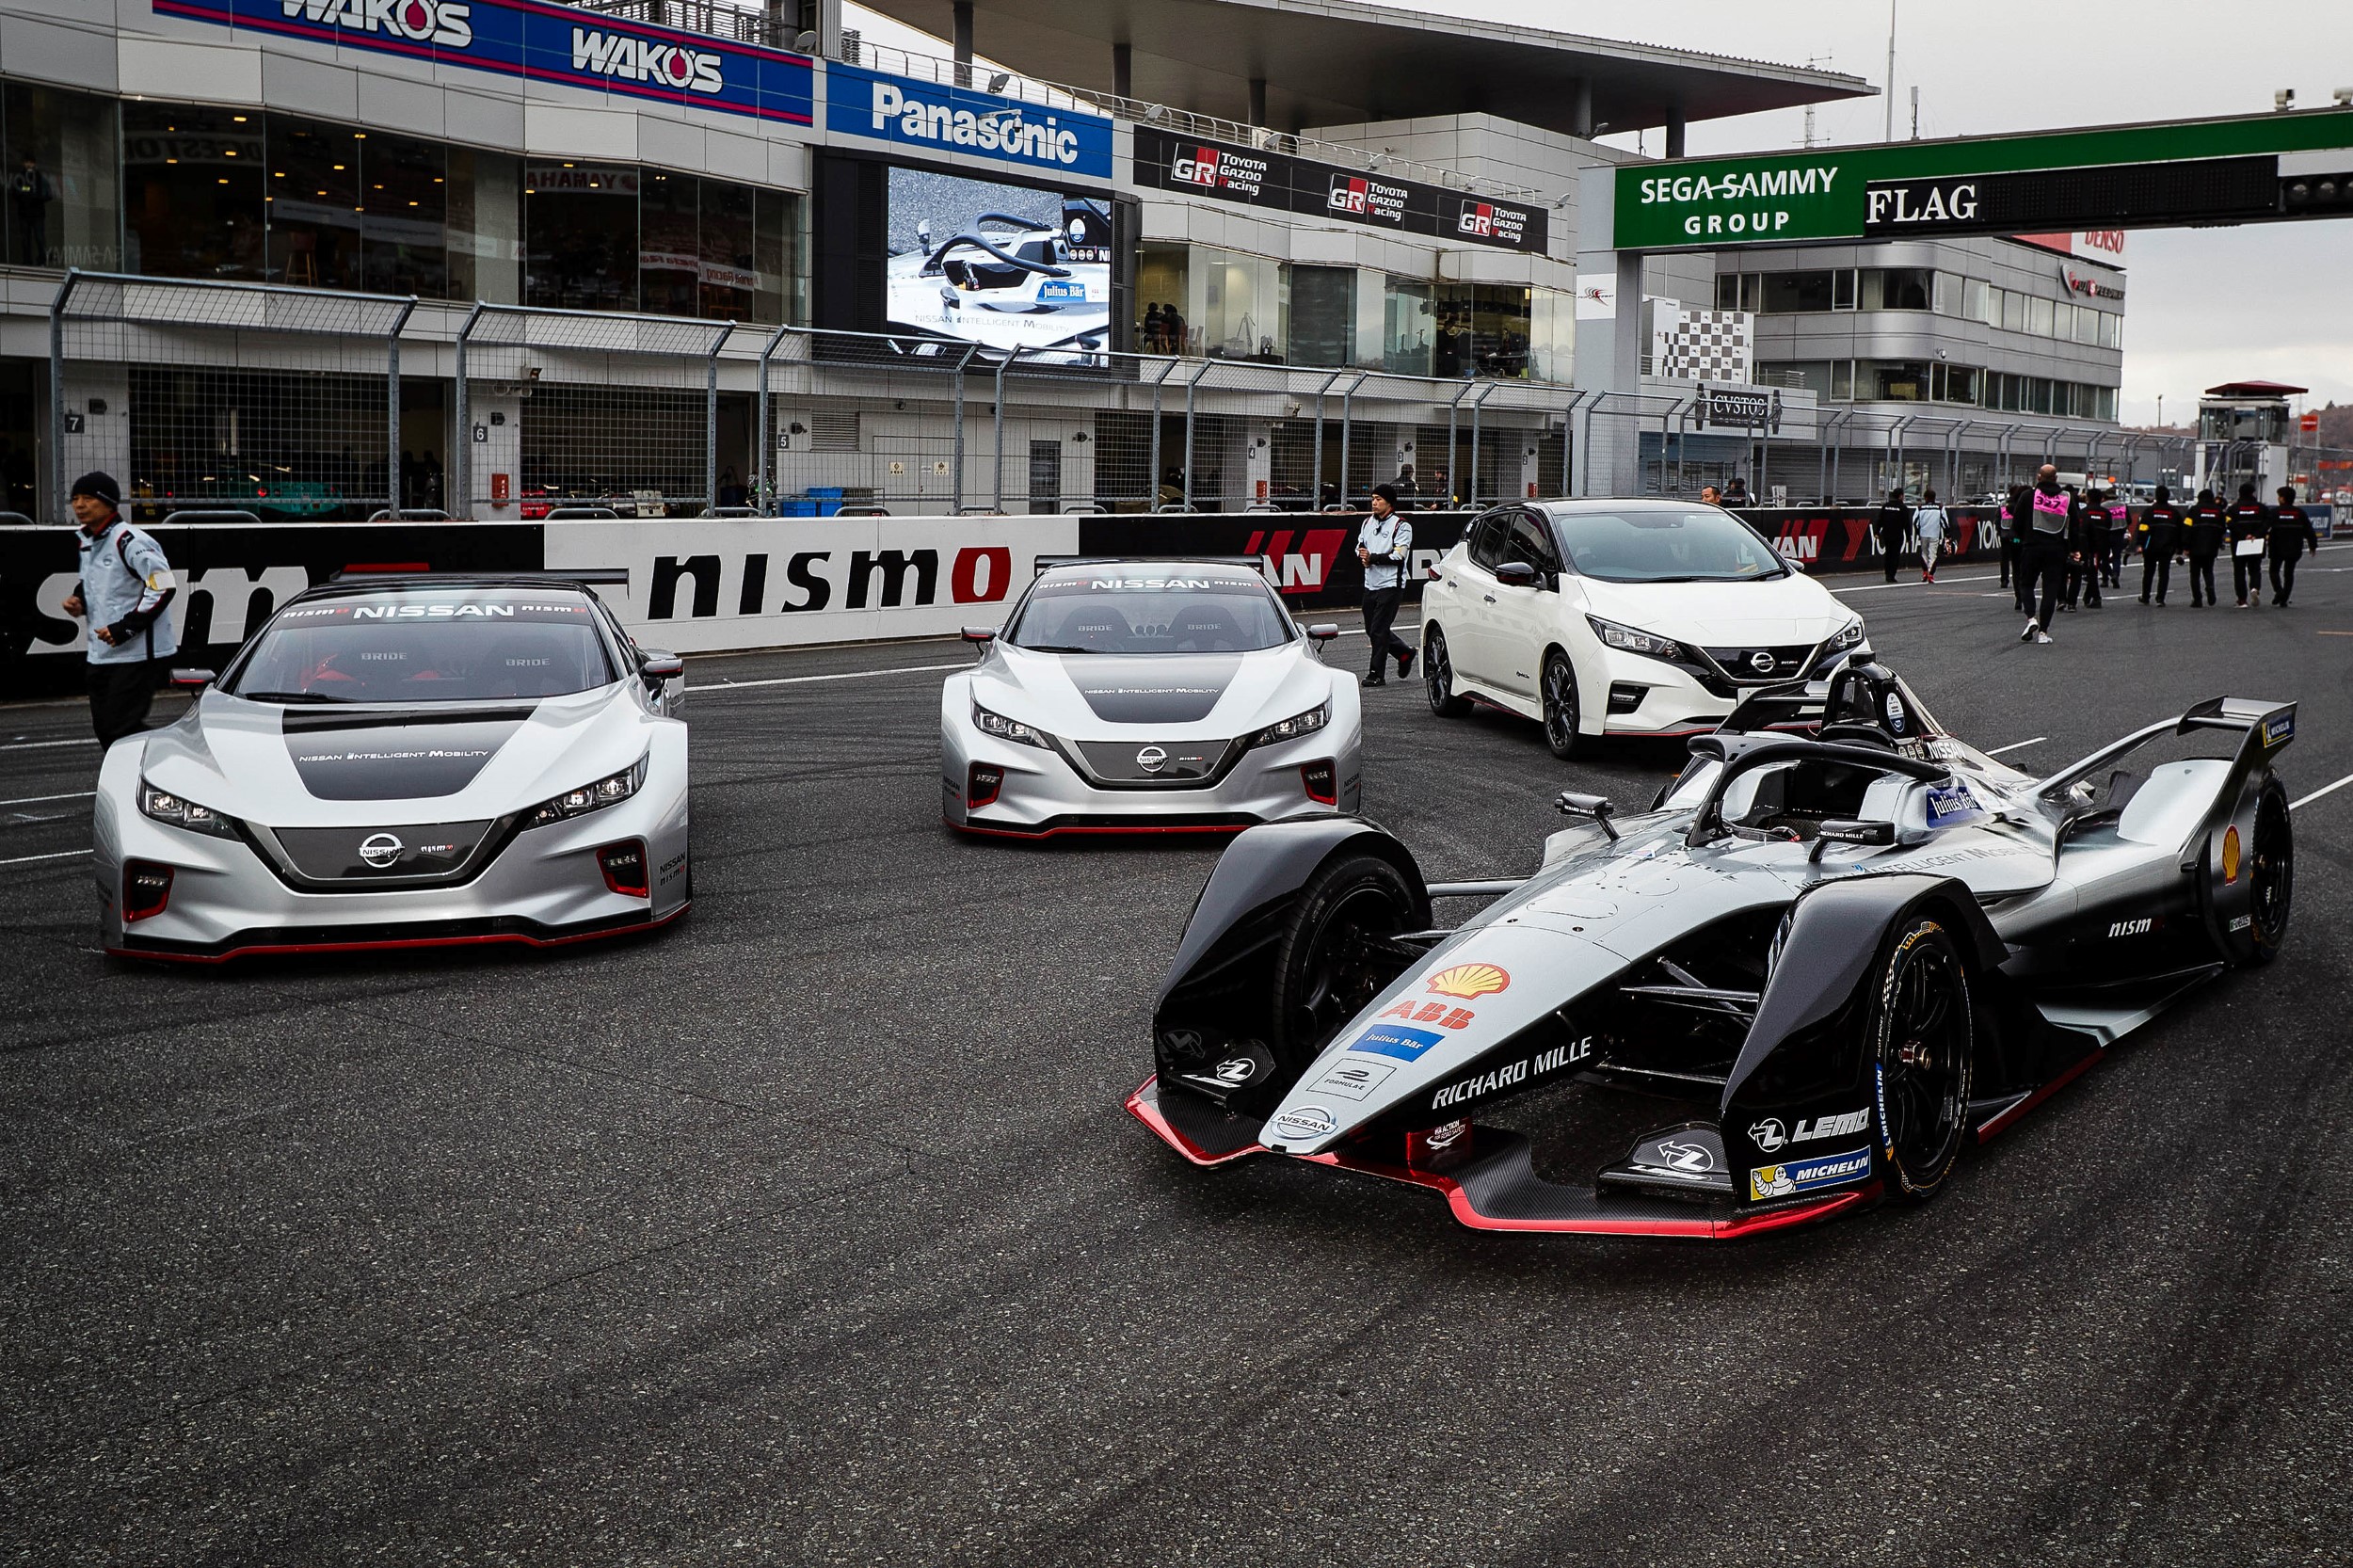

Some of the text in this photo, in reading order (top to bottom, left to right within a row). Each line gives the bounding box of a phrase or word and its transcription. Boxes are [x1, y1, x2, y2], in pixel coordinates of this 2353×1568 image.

[573, 27, 722, 93] WAKO'S
[872, 81, 1078, 164] Panasonic
[1222, 152, 1267, 171] TOYOTA
[1175, 158, 1214, 184] GR
[1220, 165, 1261, 182] GAZOO
[1218, 176, 1259, 196] Racing
[1369, 182, 1408, 199] TOYOTA
[1641, 167, 1838, 204] SEGA SAMMY
[1330, 188, 1364, 211] GR
[1368, 193, 1403, 208] GAZOO
[1866, 184, 1978, 224] FLAG
[1367, 204, 1401, 221] Racing
[1494, 207, 1527, 222] TOYOTA
[1461, 213, 1490, 233] GR
[1493, 217, 1523, 232] GAZOO
[1685, 211, 1789, 234] GROUP
[1492, 227, 1521, 243] Racing
[2085, 231, 2123, 254] DENSO
[1044, 285, 1067, 298] Julius
[1069, 285, 1084, 297] Bär
[915, 315, 952, 324] NISSAN
[69, 418, 80, 430] 7
[476, 428, 484, 440] 6
[781, 436, 787, 447] 5
[1249, 449, 1255, 457] 4
[2035, 496, 2061, 509] 327
[648, 546, 1012, 620] nismo
[1091, 579, 1210, 590] NISSAN
[282, 604, 585, 619] nismo NISSAN nismo
[361, 652, 408, 661] BRIDE
[505, 658, 551, 666] BRIDE
[347, 751, 425, 760] INTELLIGENT
[428, 749, 489, 758] MOBILITY
[1927, 742, 1966, 760] NISSAN
[1929, 793, 1961, 819] Julius
[660, 851, 685, 874] NISSAN
[1378, 1000, 1476, 1030] ABB
[1366, 1032, 1424, 1049] Julius Bär
[1432, 1036, 1593, 1110] RICHARD MILLE
[1877, 1069, 1889, 1137] MICHELIN
[1277, 1115, 1331, 1131] NISSAN
[1792, 1107, 1869, 1143] LEMO
[1796, 1155, 1868, 1181] MICHELIN
